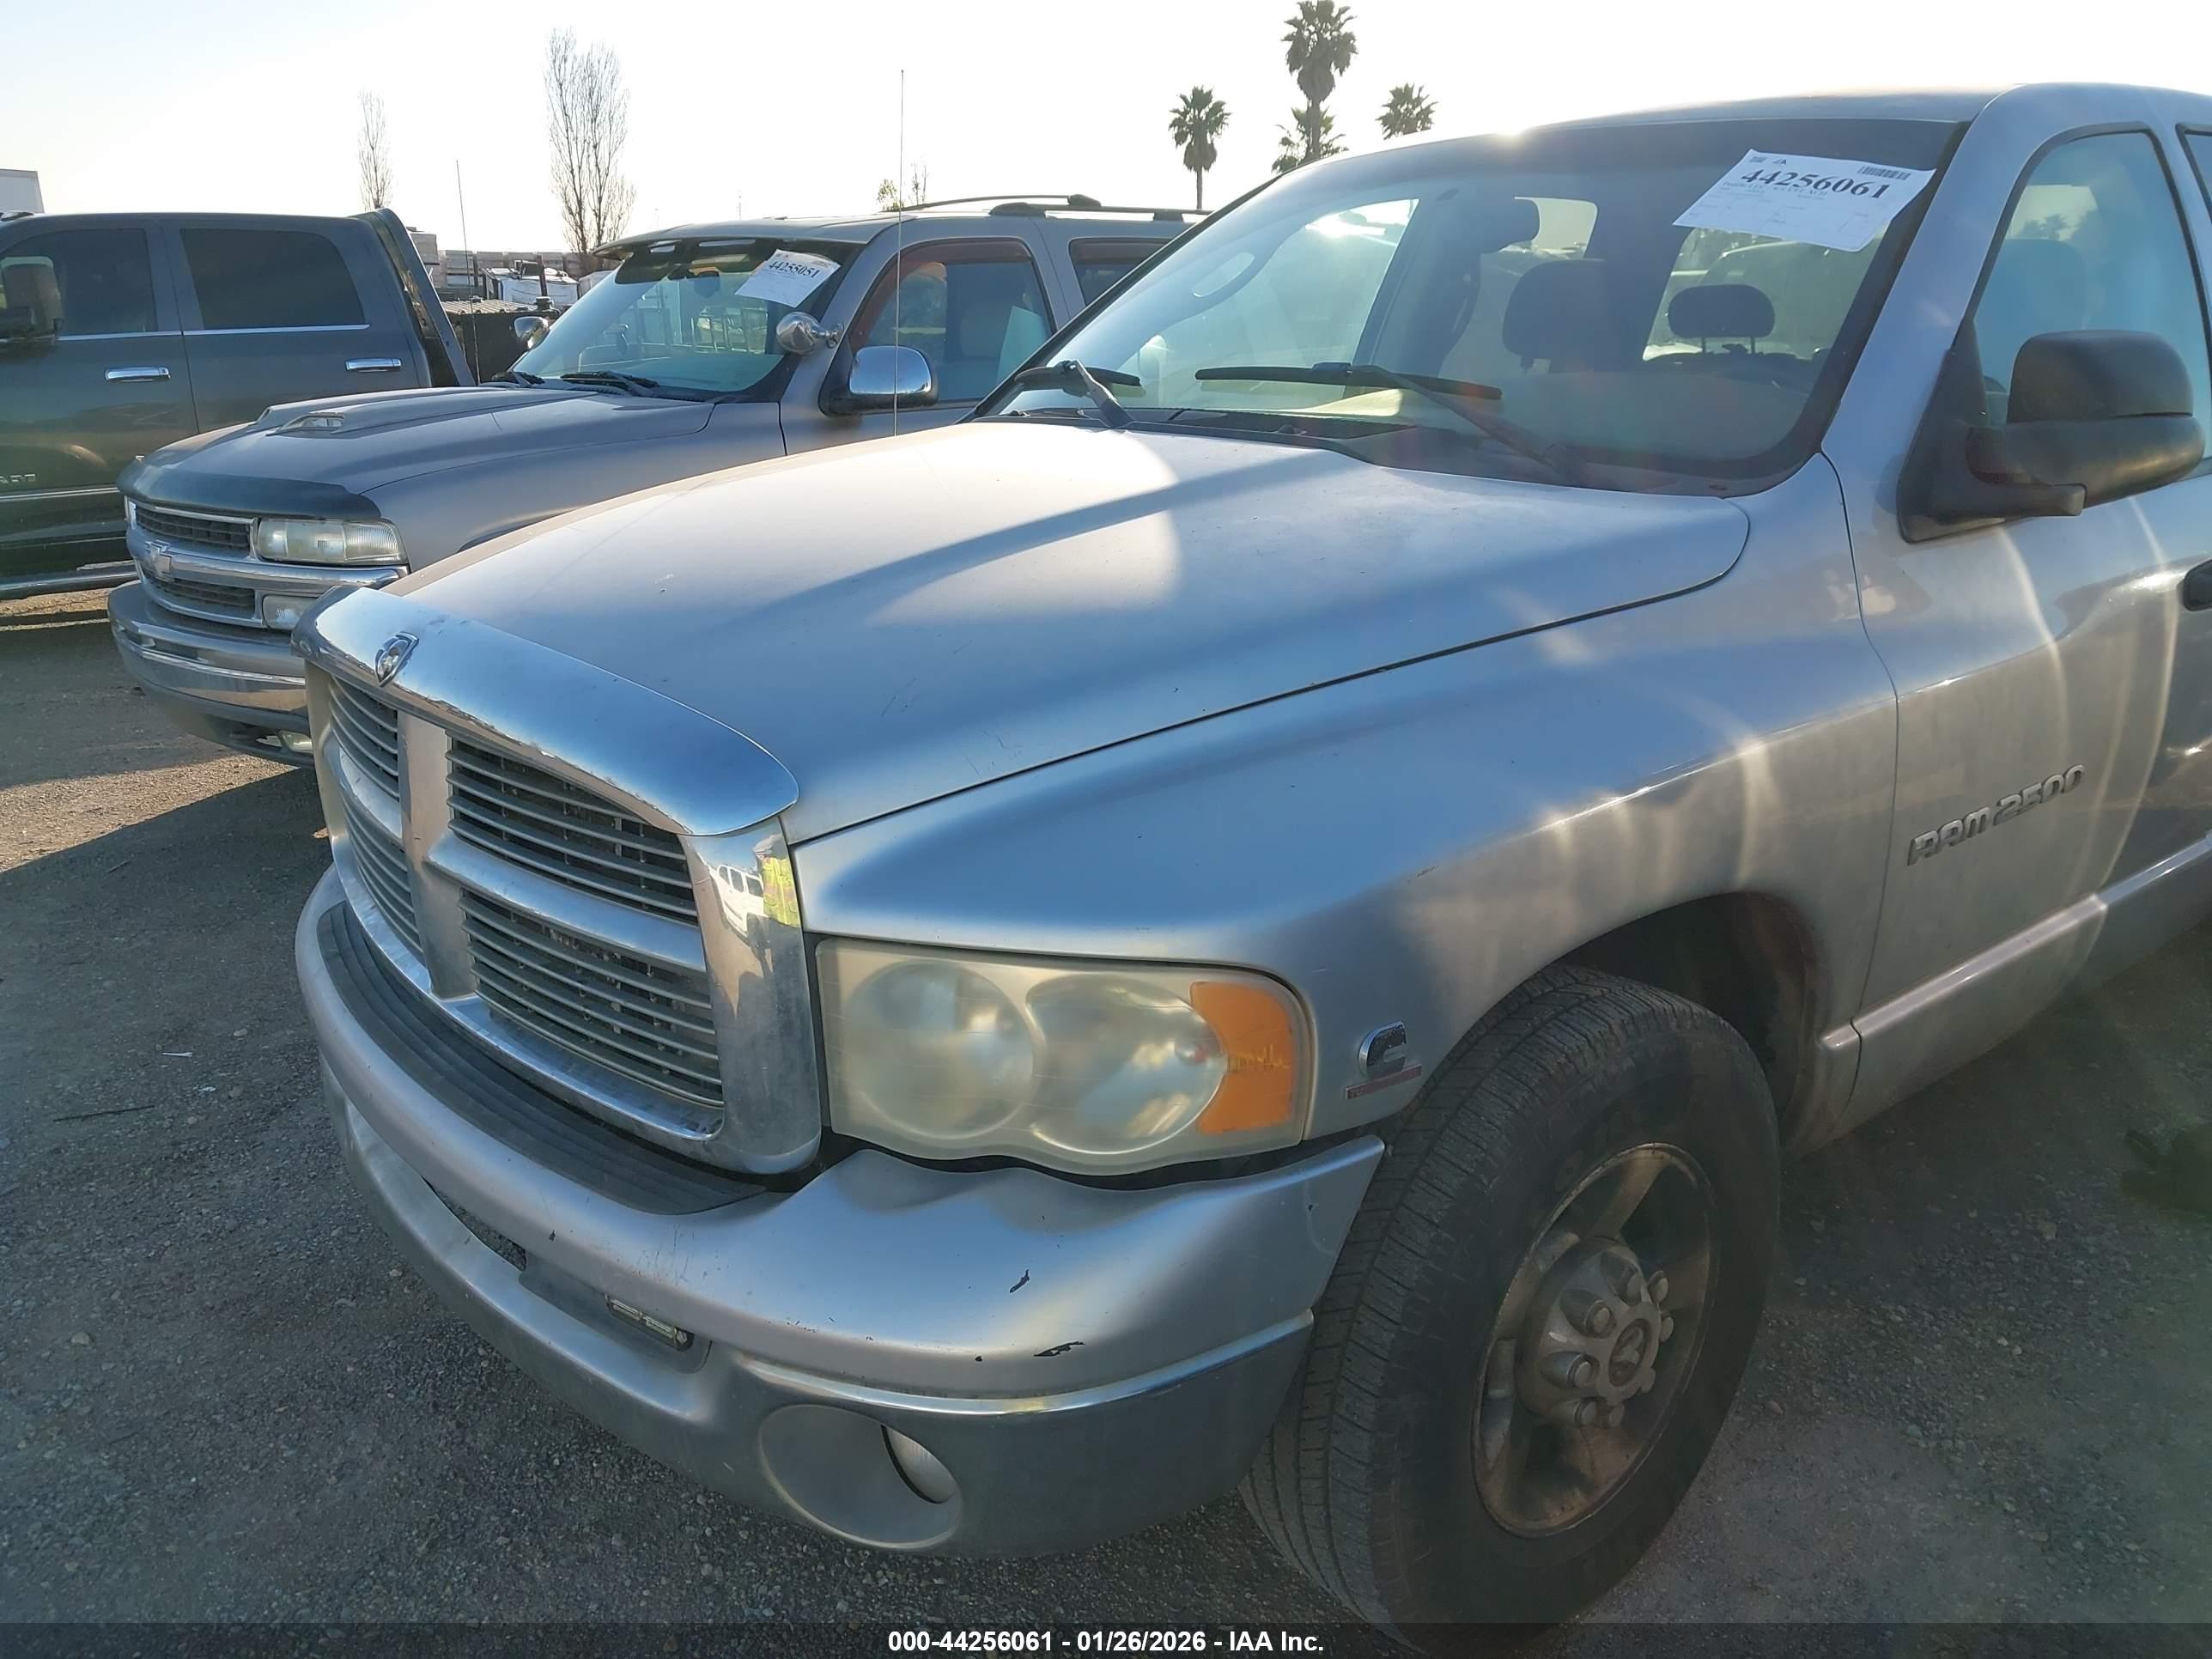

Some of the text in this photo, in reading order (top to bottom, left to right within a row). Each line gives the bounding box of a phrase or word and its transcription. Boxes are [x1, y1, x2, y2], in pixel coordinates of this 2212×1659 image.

[1741, 169, 1892, 199] 44256061
[769, 260, 820, 278] 44255051
[1906, 763, 2086, 866] RAM 2500
